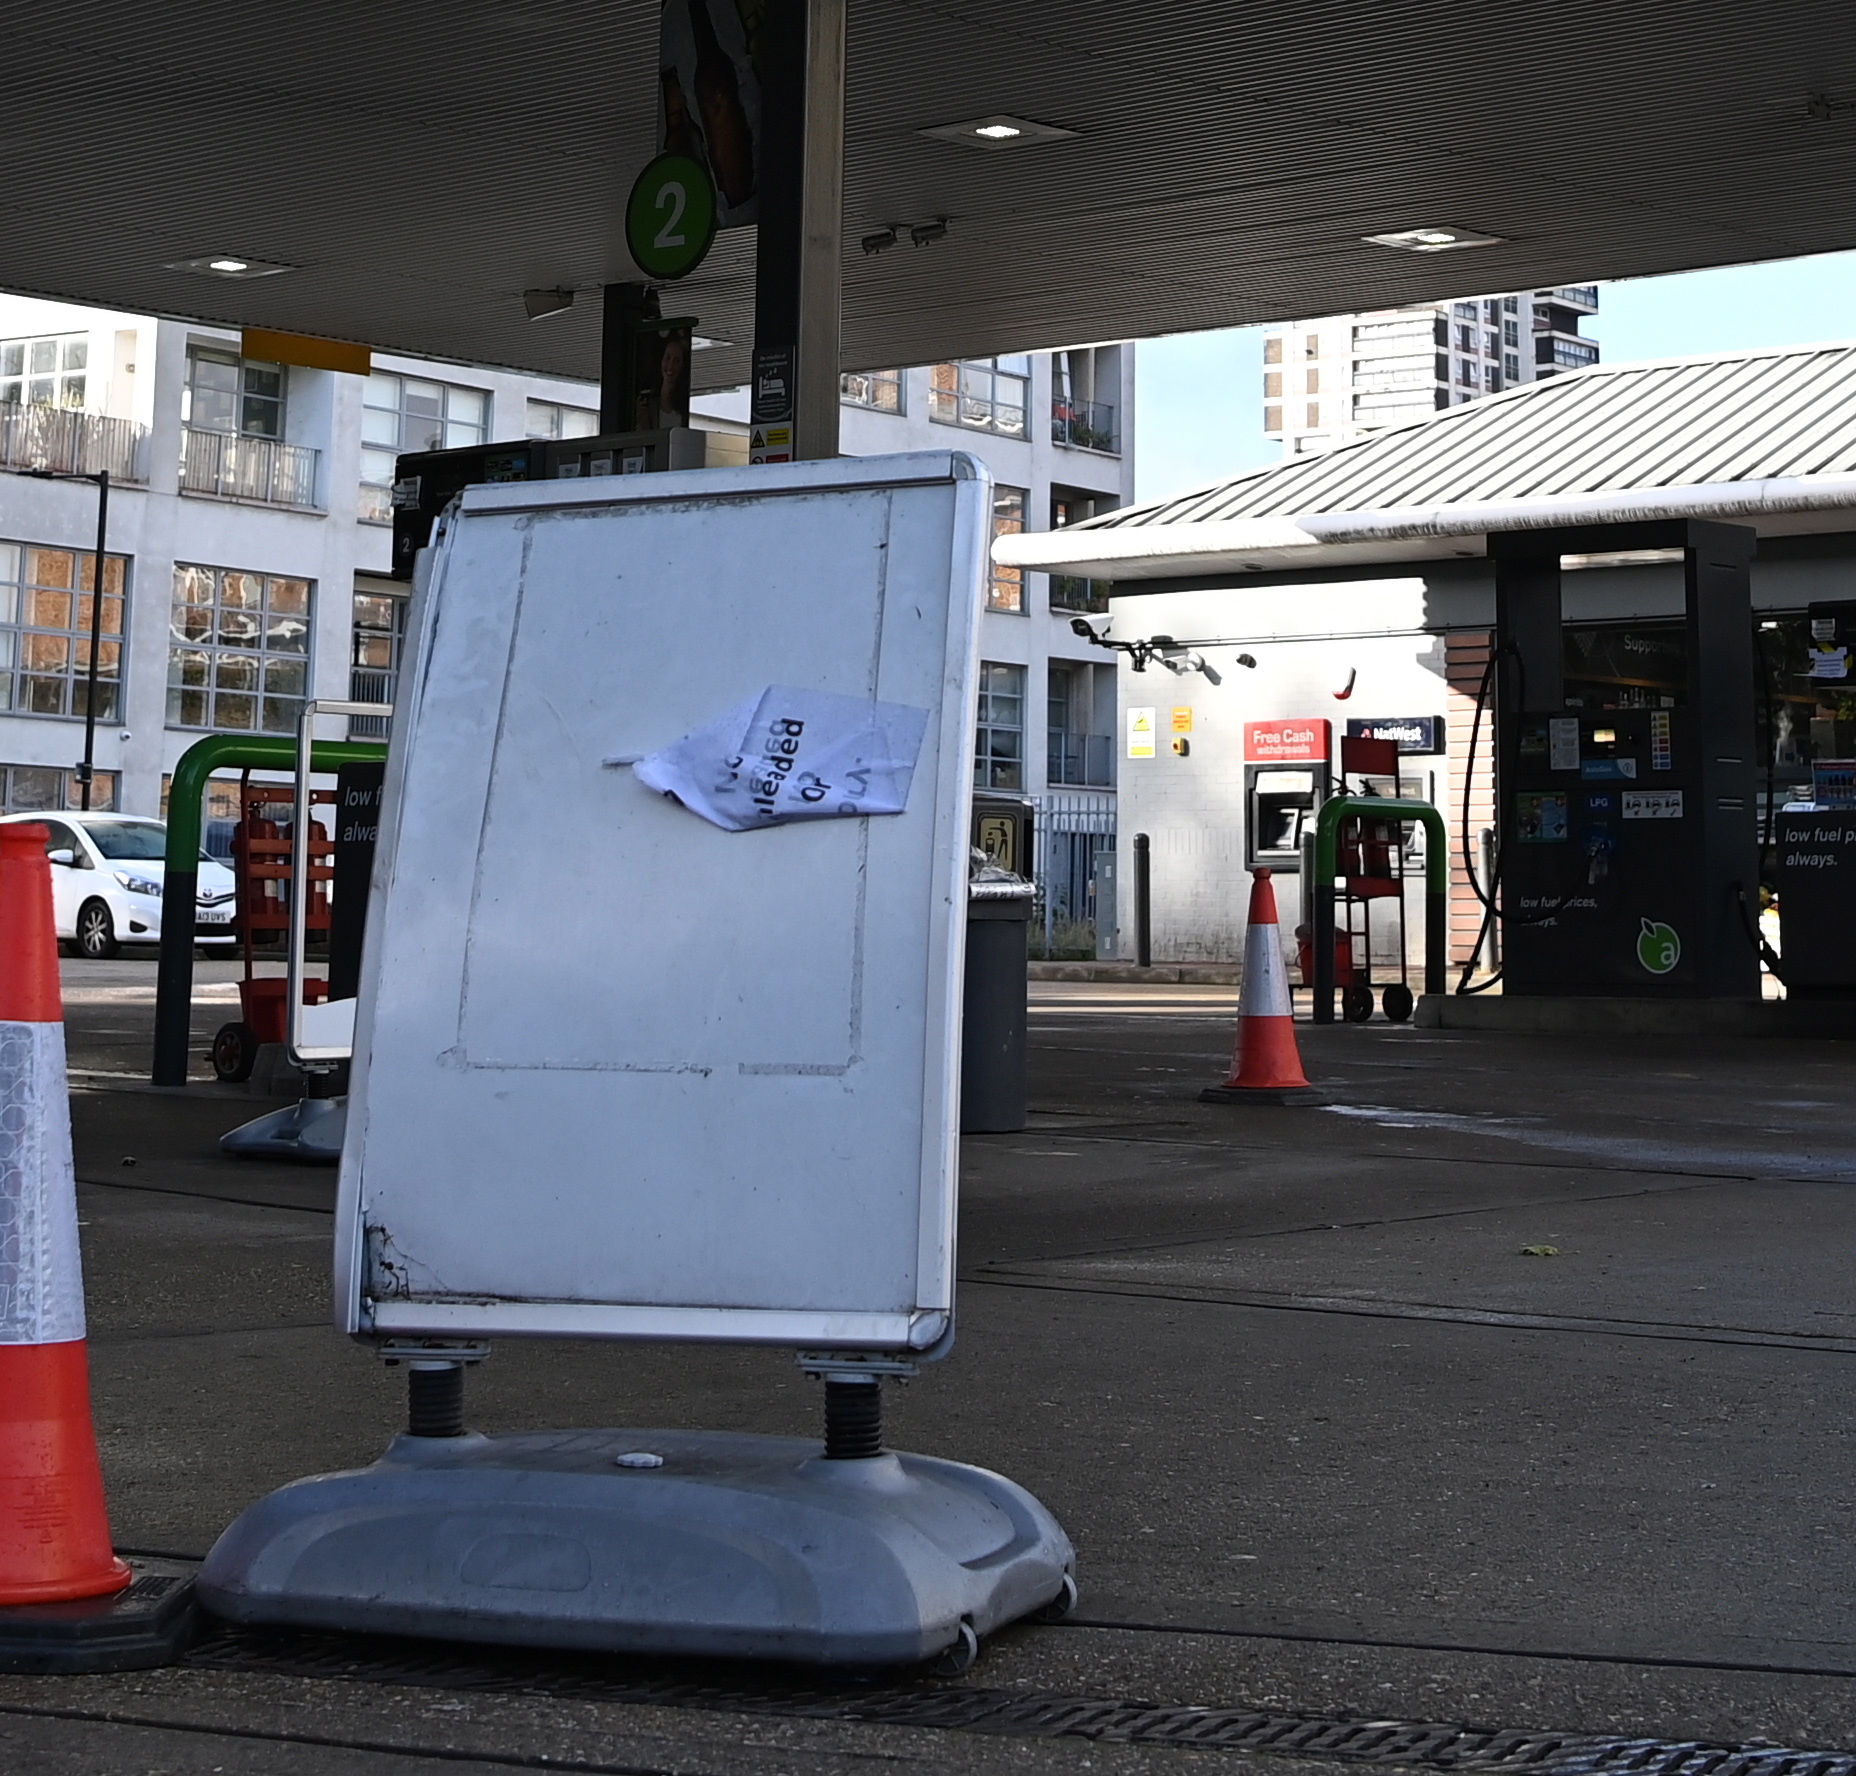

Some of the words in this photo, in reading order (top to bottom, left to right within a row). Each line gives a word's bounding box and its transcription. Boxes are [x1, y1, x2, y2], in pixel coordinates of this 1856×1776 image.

[654, 181, 686, 249] 2
[403, 536, 411, 553] 2
[1254, 729, 1281, 744] Free
[1283, 728, 1314, 742] Cash
[1374, 726, 1422, 741] NatWest
[1257, 743, 1310, 755] withdrawals
[753, 718, 805, 818] leaded
[345, 786, 372, 806] low
[801, 777, 831, 802] Or
[1589, 798, 1609, 807] LPG
[343, 821, 378, 842] alwa
[1785, 828, 1811, 842] low
[1814, 826, 1843, 842] fuel
[1785, 851, 1838, 869] always.
[1520, 896, 1539, 908] low
[1562, 896, 1598, 910] rices,
